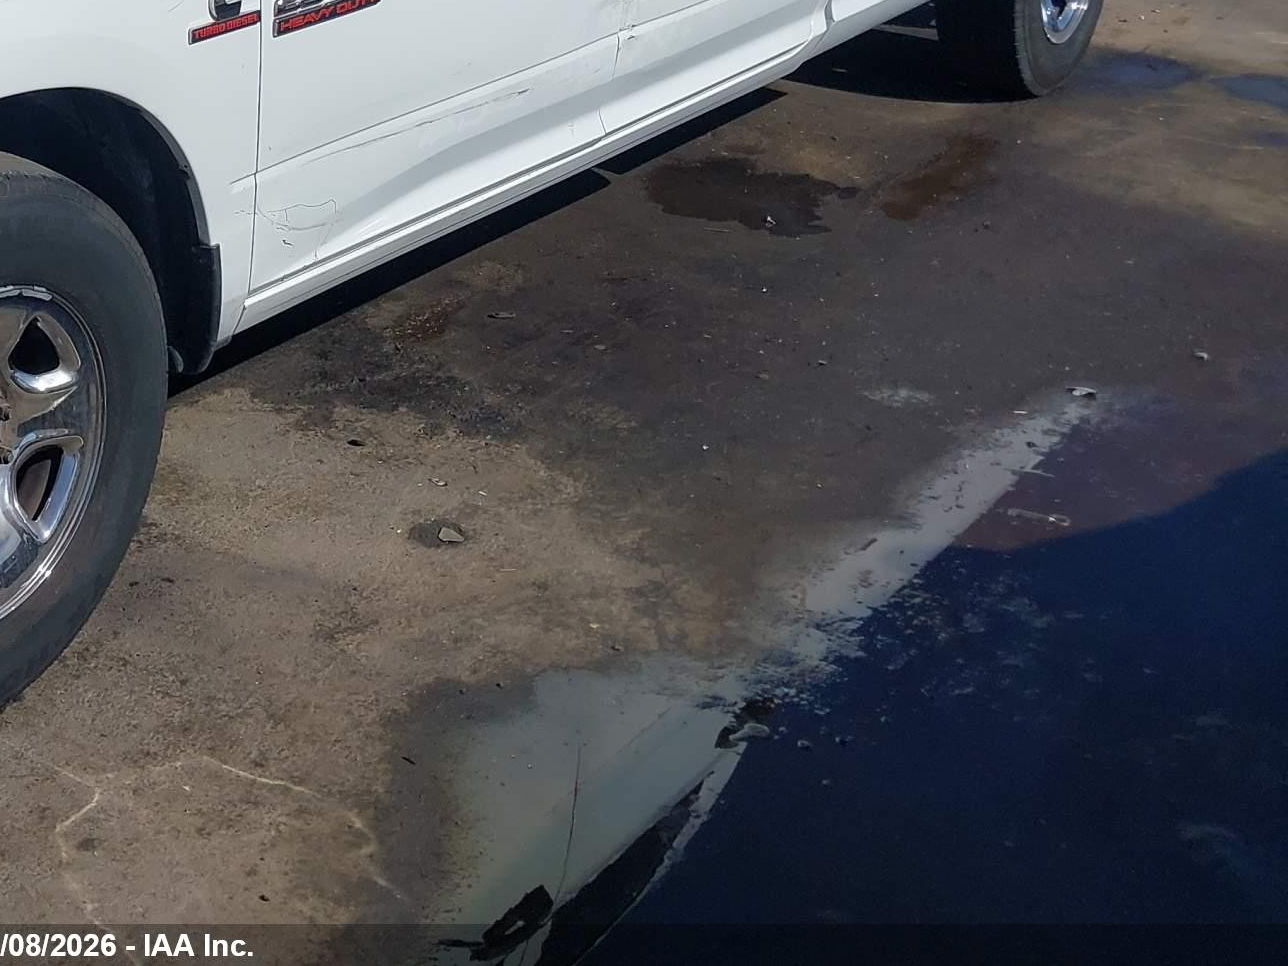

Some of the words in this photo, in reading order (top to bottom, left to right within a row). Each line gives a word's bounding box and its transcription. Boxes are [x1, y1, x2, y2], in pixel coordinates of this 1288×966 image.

[194, 22, 225, 39] TURBO
[227, 14, 260, 32] DIESEL
[280, 6, 335, 31] HEAVY
